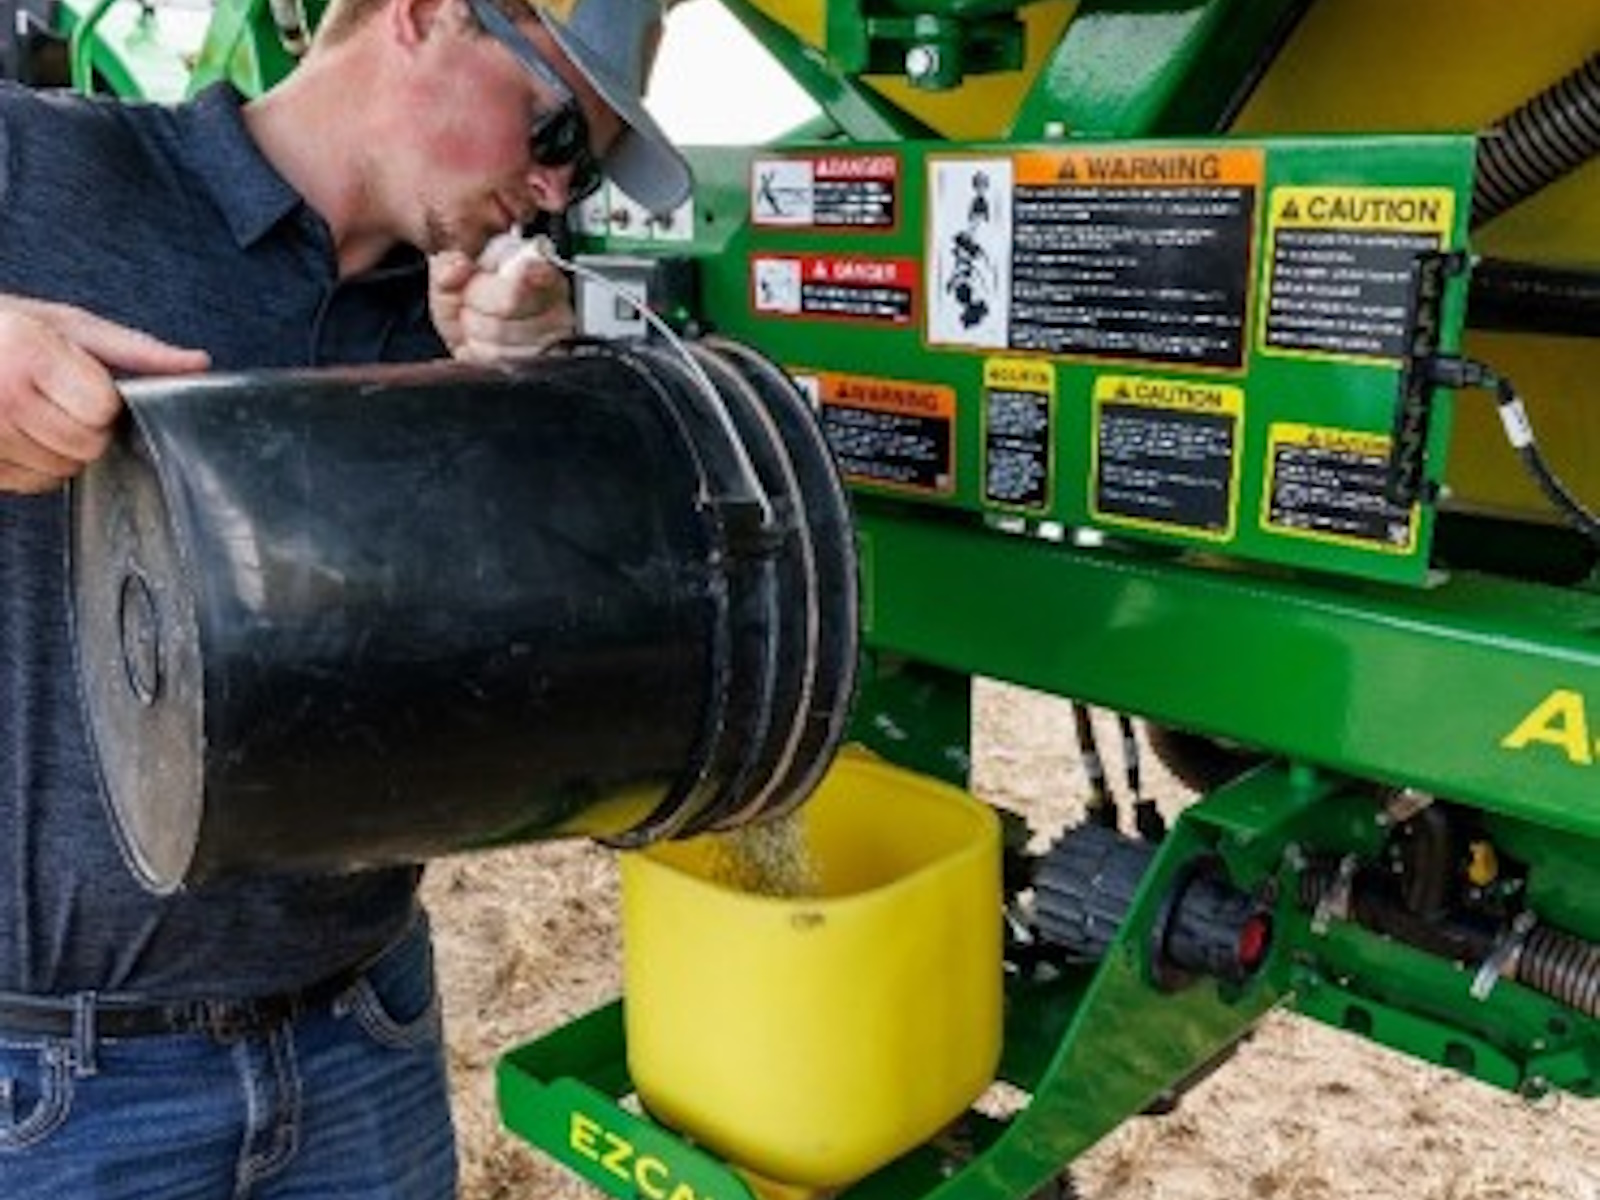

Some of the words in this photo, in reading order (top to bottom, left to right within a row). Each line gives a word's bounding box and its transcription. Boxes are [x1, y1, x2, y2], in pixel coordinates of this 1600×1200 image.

[1086, 154, 1219, 181] WARNING
[1307, 195, 1440, 223] CAUTION
[1135, 383, 1222, 408] CAUTION
